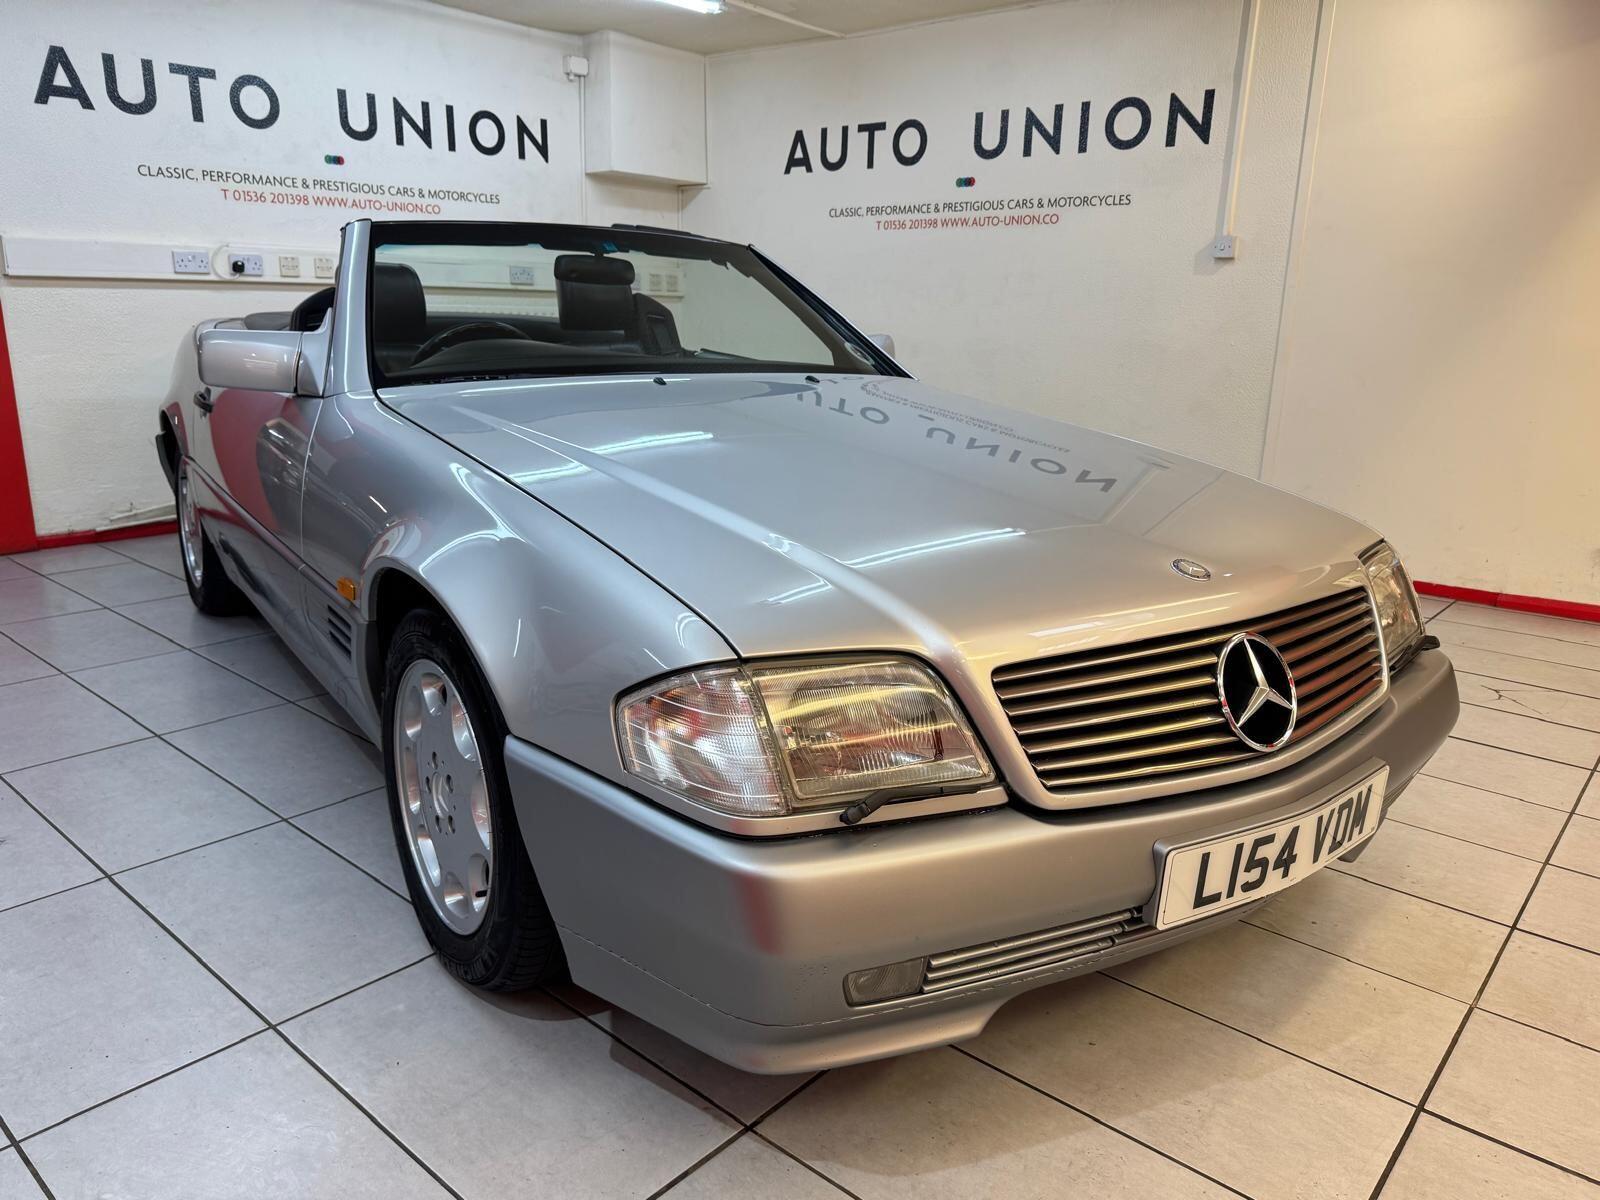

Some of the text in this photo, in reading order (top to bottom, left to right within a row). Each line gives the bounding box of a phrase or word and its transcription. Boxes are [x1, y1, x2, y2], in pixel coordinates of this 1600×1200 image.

[34, 45, 550, 164] AUTO UNION
[784, 88, 1216, 175] AUTO UNION
[137, 164, 501, 205] CLASSIC, PERFORMANCE & PRESTIGIOUS CARS & MOTORCYCLES
[220, 188, 441, 215] T 01536 201398 WWW.AUTO-UNION.CO
[829, 194, 1132, 219] CLASSIC, PERFORMANCE & PRESTIGIOUS CARS & MOTORCYCLES
[876, 213, 1060, 231] T 01536 201398 WWW.AUTO-UNION.CO
[1193, 784, 1373, 910] L154 VDM
